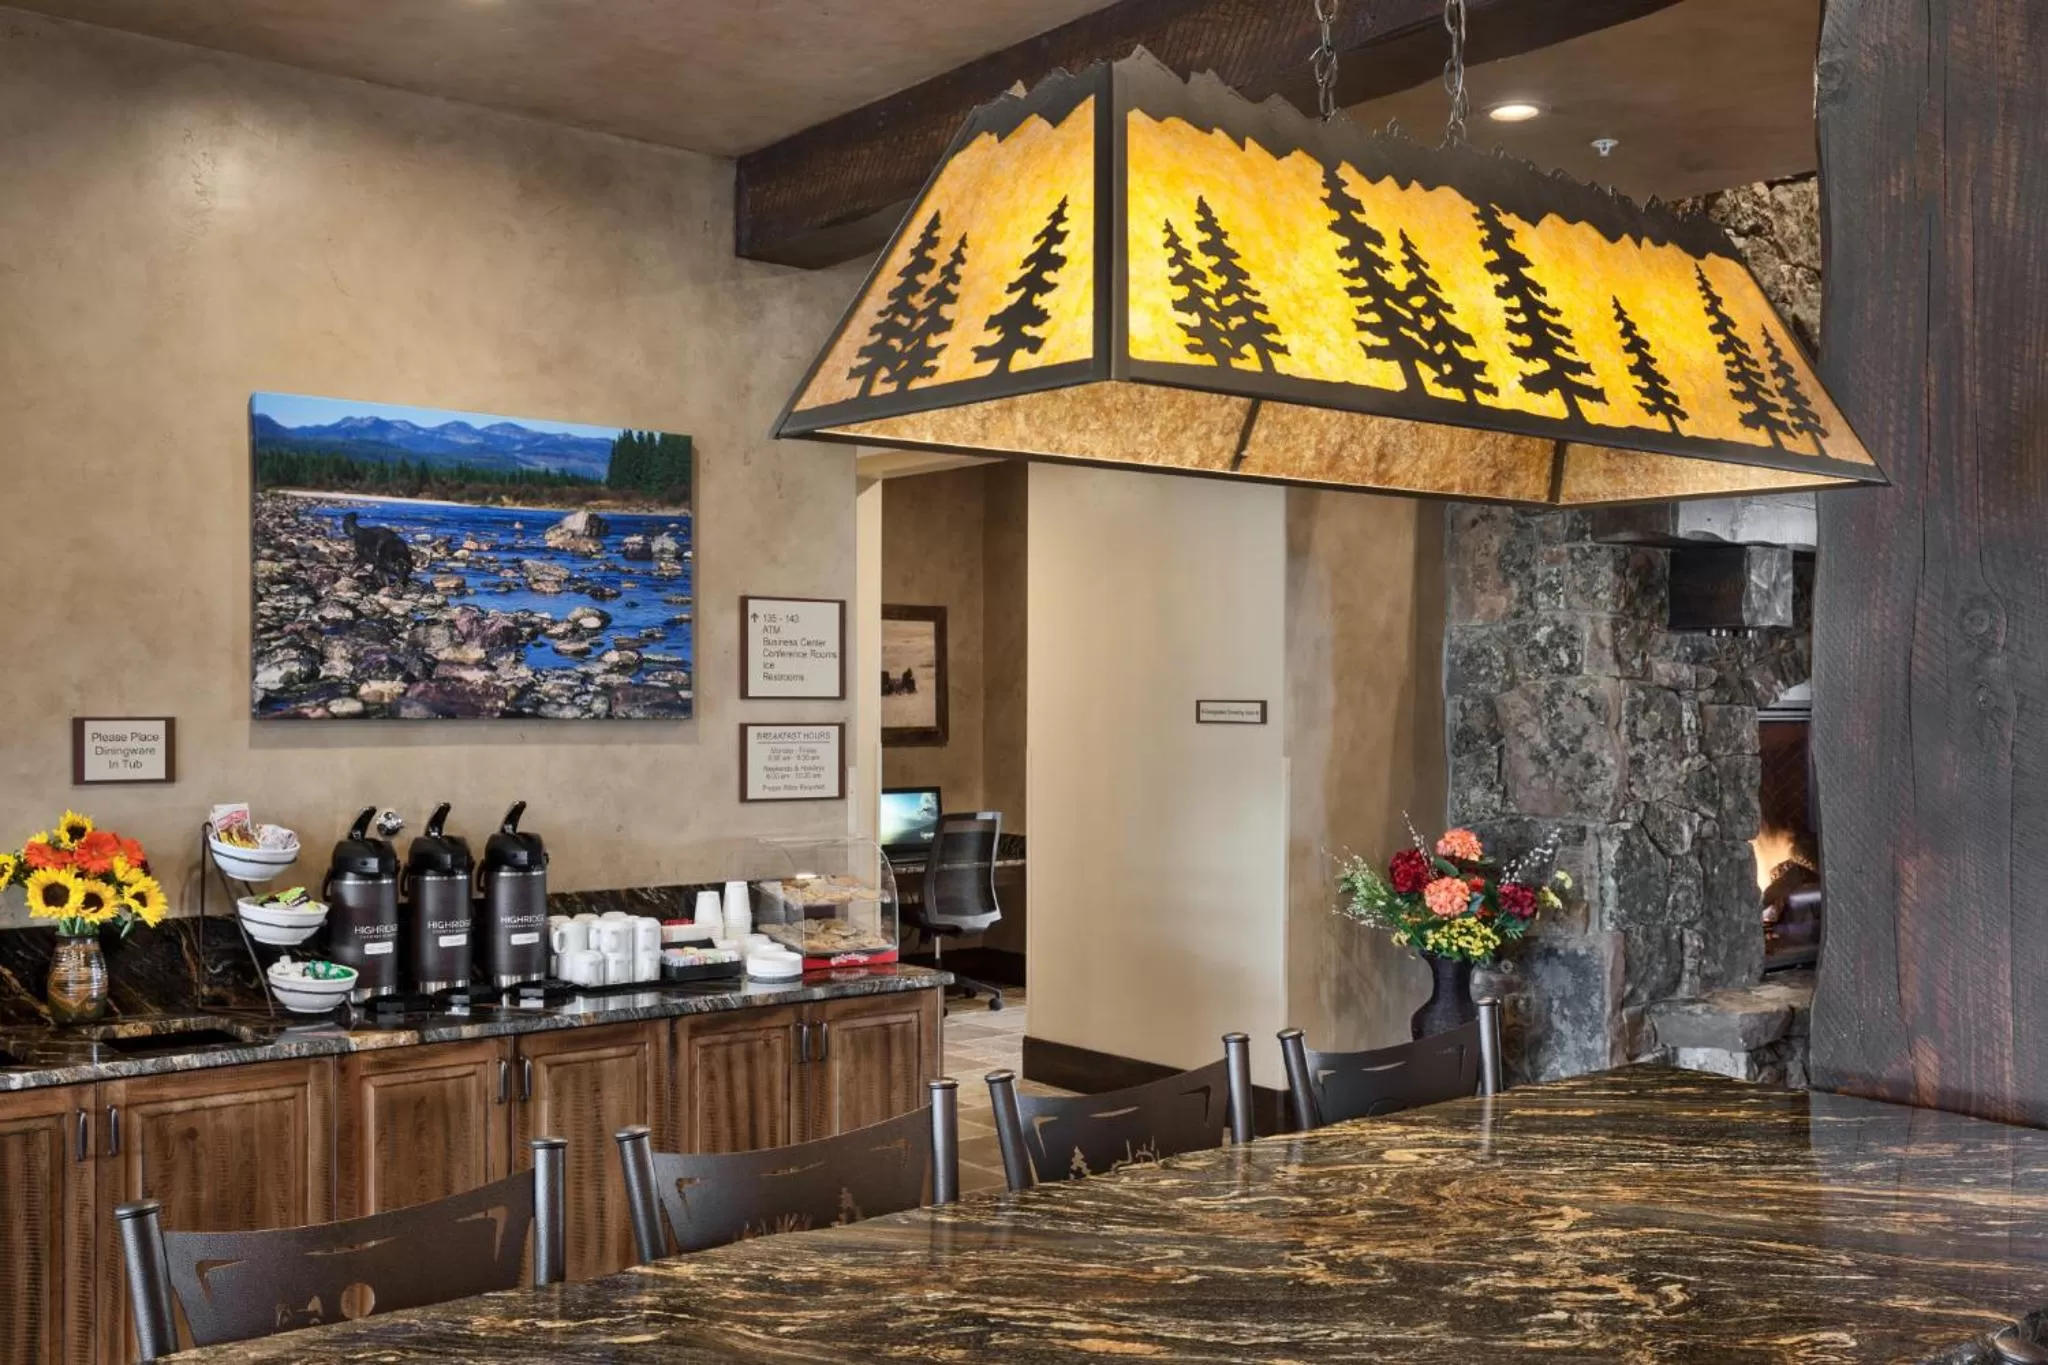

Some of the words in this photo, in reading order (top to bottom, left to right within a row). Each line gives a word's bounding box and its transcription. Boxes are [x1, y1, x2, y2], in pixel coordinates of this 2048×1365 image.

[763, 625, 780, 634] ATM
[763, 637, 798, 647] Business
[800, 638, 826, 647] Center
[763, 648, 807, 658] Conference
[811, 649, 837, 659] Rooms
[763, 672, 805, 682] Restrooms
[91, 732, 127, 742] Please
[130, 732, 159, 742] Place
[756, 731, 801, 740] BREAKFAST
[804, 731, 831, 740] HOURS
[95, 746, 156, 757] Diningware
[108, 760, 119, 769] In
[121, 759, 142, 769] Tub
